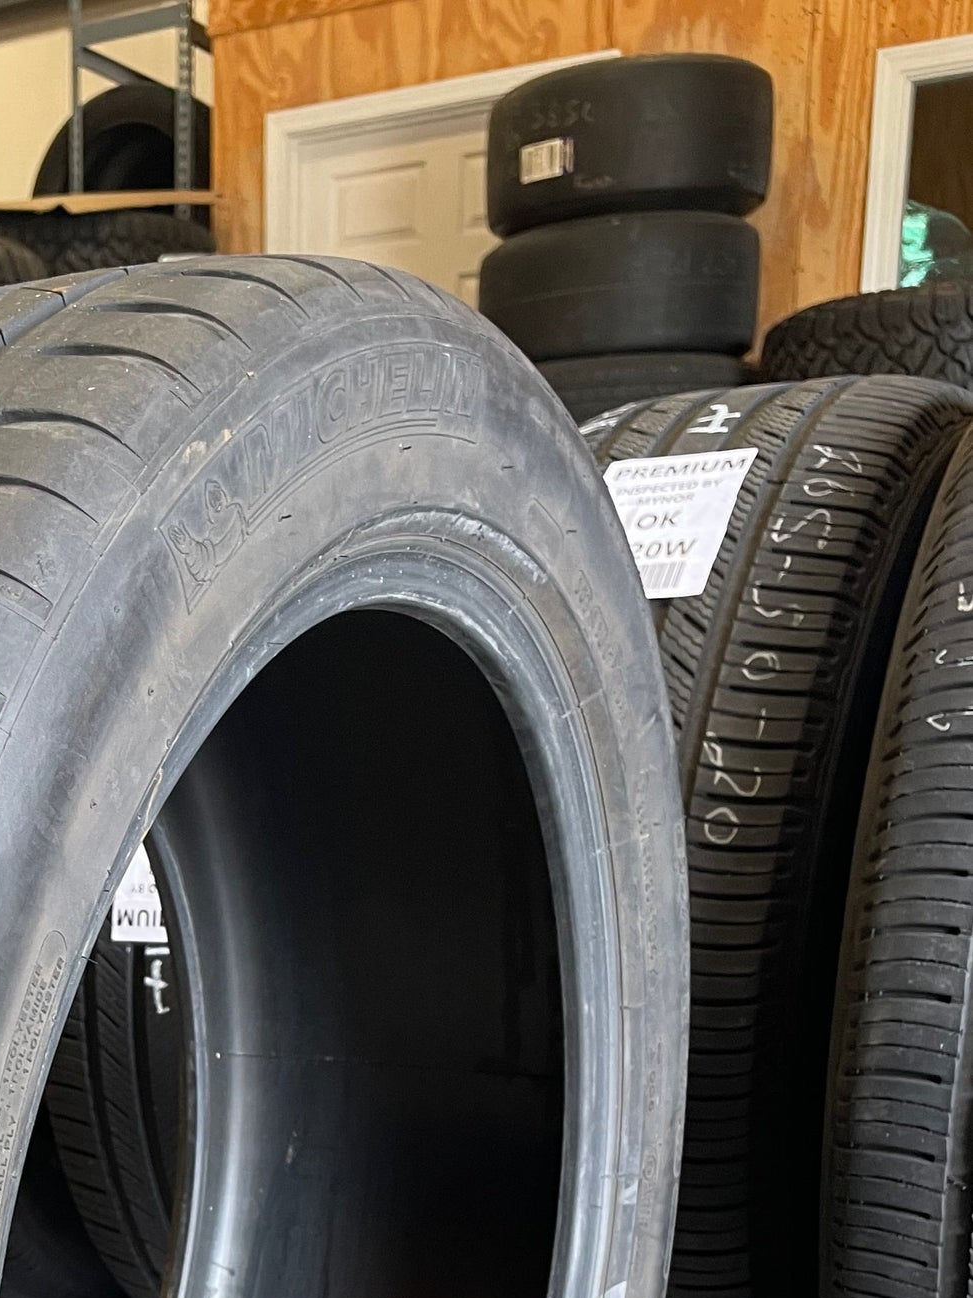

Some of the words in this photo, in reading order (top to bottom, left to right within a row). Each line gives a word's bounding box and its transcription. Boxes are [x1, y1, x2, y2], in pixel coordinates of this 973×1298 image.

[241, 350, 486, 508] MICHELIN
[613, 457, 748, 481] PREMIUM
[616, 481, 699, 496] INSPECTED
[702, 478, 724, 489] BY
[637, 508, 682, 529] OK
[632, 537, 696, 560] 20W
